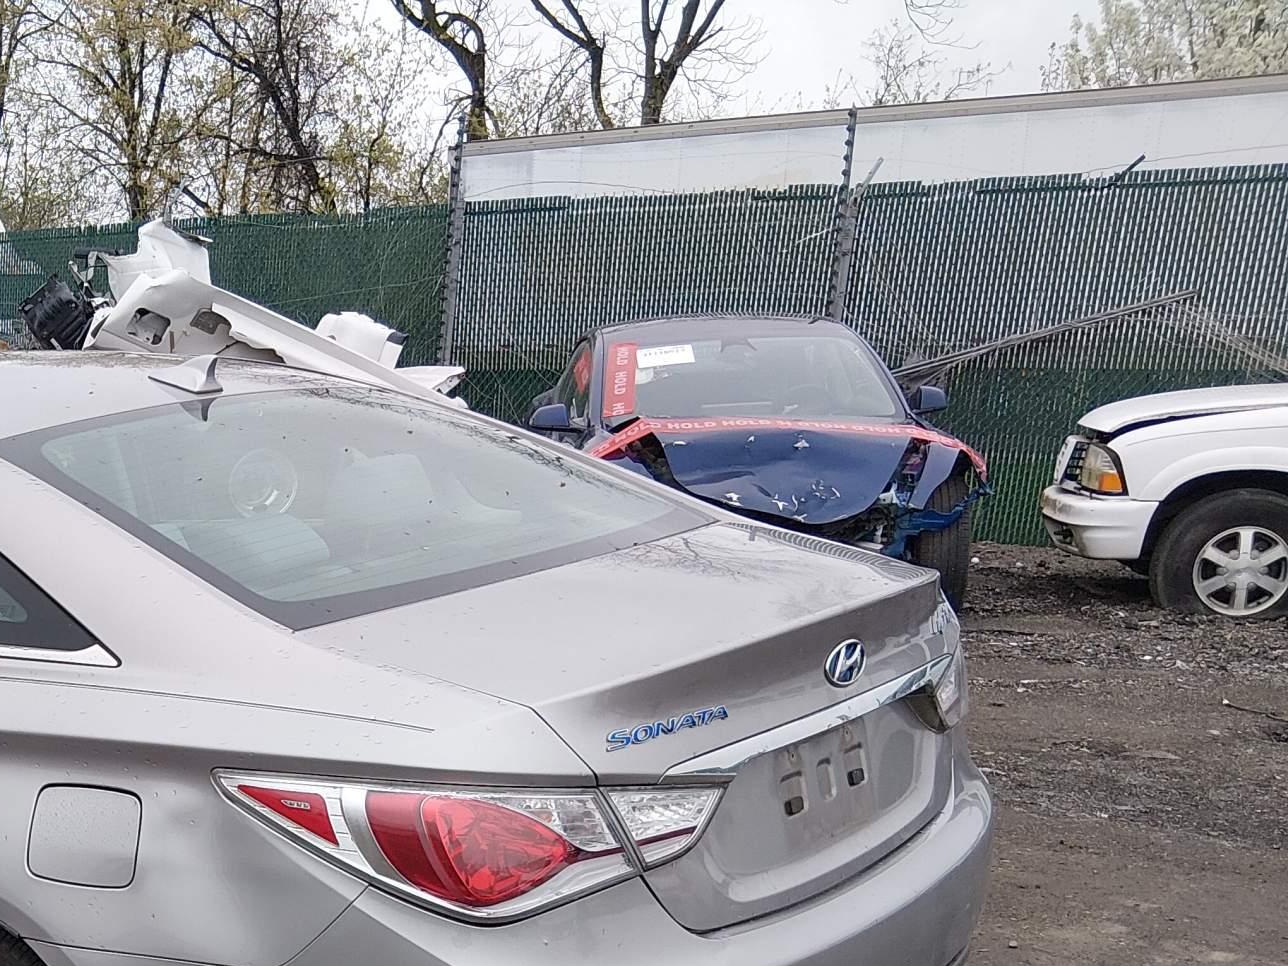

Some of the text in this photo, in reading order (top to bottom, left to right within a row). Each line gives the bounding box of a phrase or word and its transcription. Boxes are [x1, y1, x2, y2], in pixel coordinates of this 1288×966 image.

[616, 346, 629, 366] HOLD
[614, 371, 628, 395] HOLD
[667, 421, 717, 430] HOLD
[721, 419, 772, 427] HOLD
[606, 705, 729, 753] SONATA
